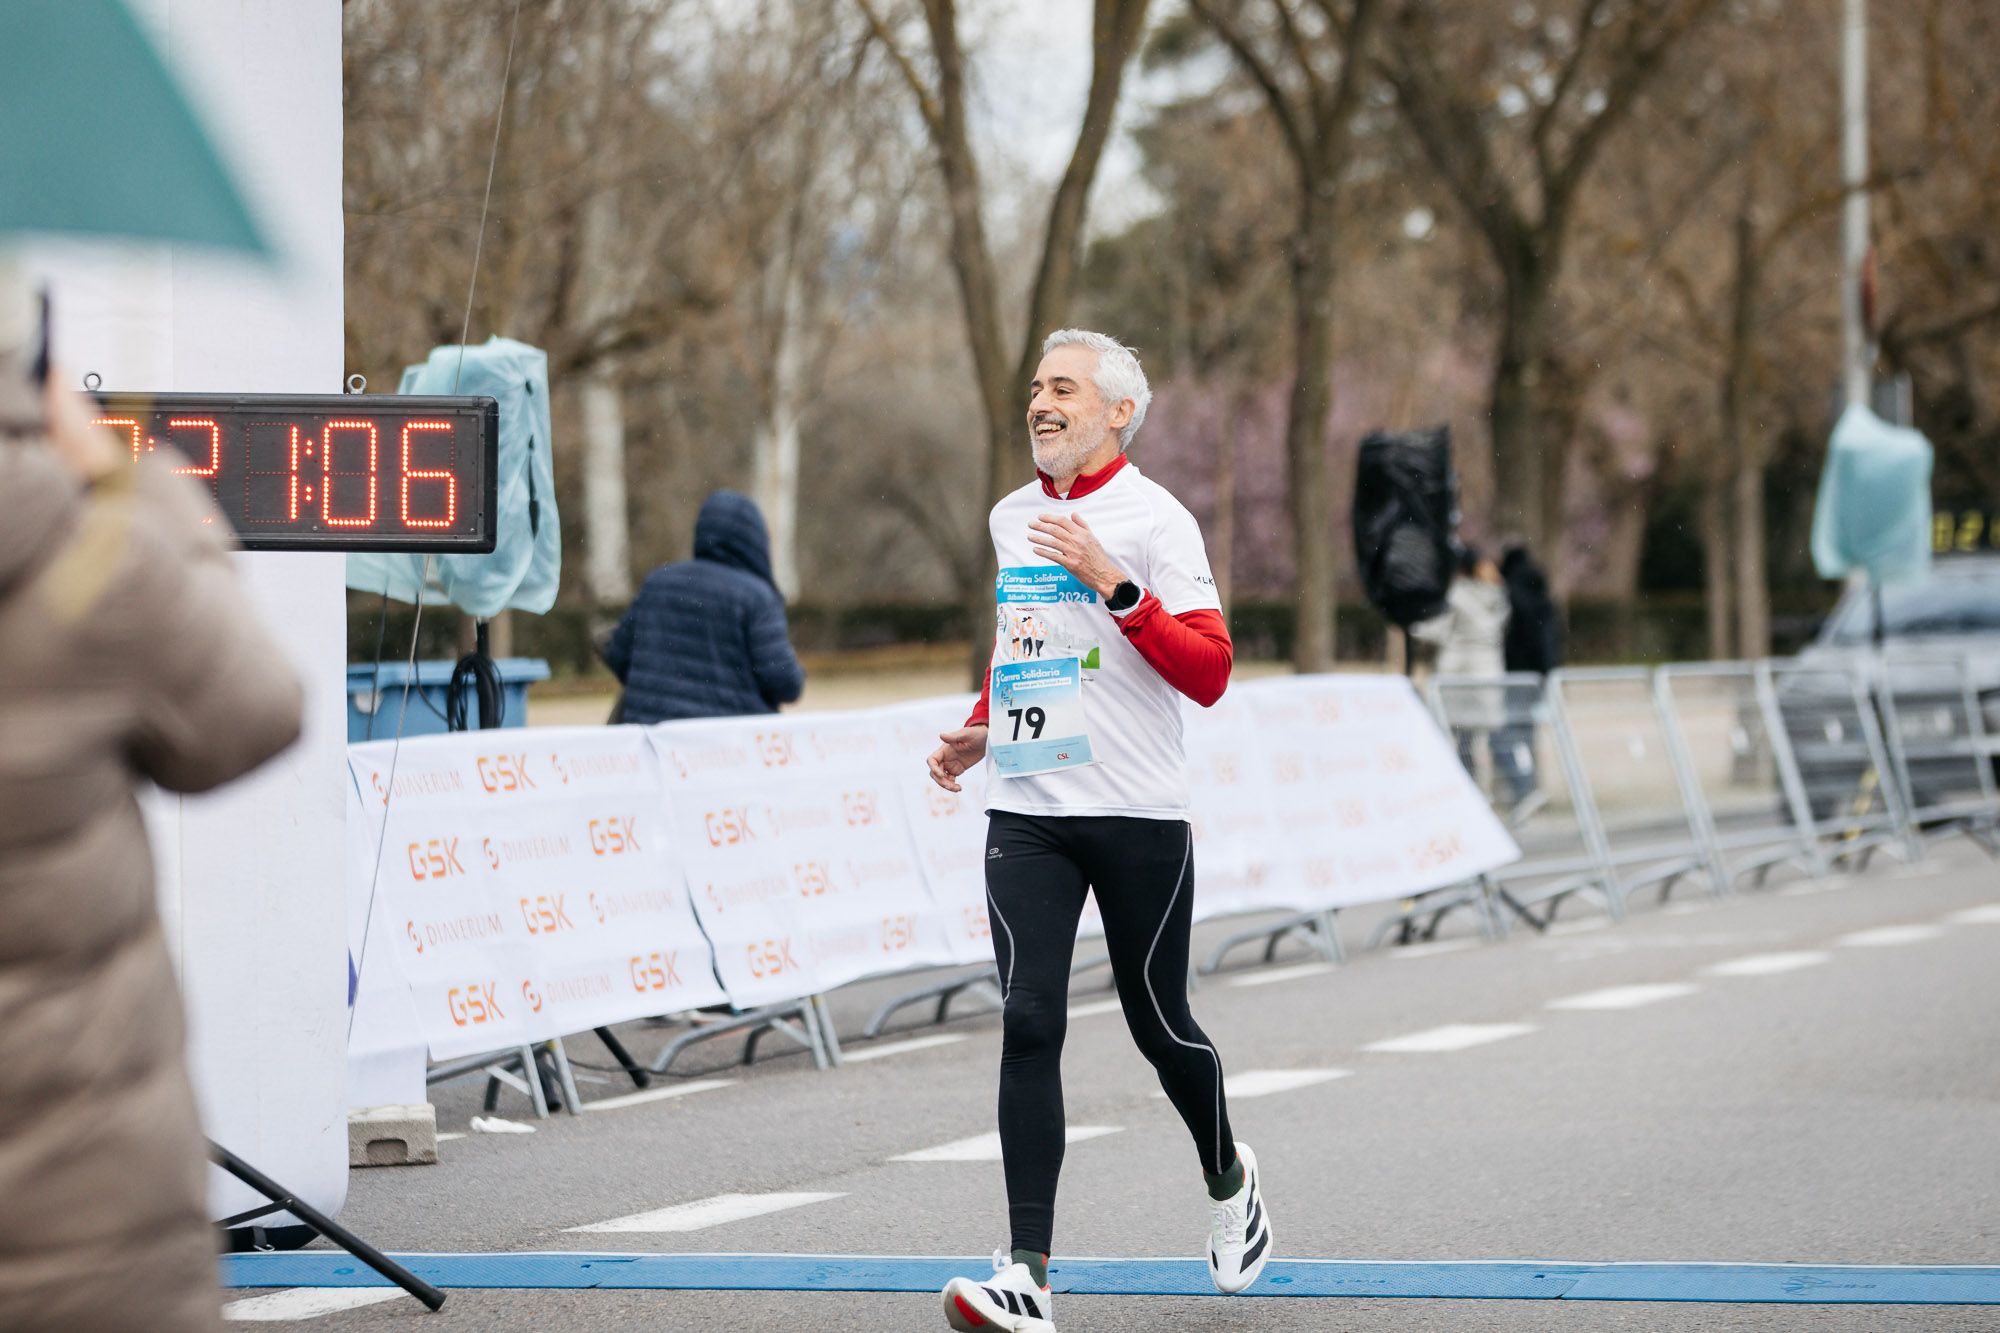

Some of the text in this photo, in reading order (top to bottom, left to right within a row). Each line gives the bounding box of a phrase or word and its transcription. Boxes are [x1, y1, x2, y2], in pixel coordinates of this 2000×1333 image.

[1005, 574, 1032, 583] Carrera
[1034, 573, 1068, 583] Solidaria
[1059, 592, 1090, 603] 2026
[1021, 668, 1060, 680] Solidaria
[1008, 706, 1046, 741] 79
[477, 753, 538, 793] GSK
[704, 807, 757, 847] GSK
[408, 836, 465, 881] GSK
[589, 816, 641, 856] GSK
[425, 913, 504, 945] DIAVERUM
[520, 893, 575, 935] GSK
[746, 937, 800, 979] GSK
[448, 981, 505, 1026] GSK
[629, 950, 683, 992] GSK
